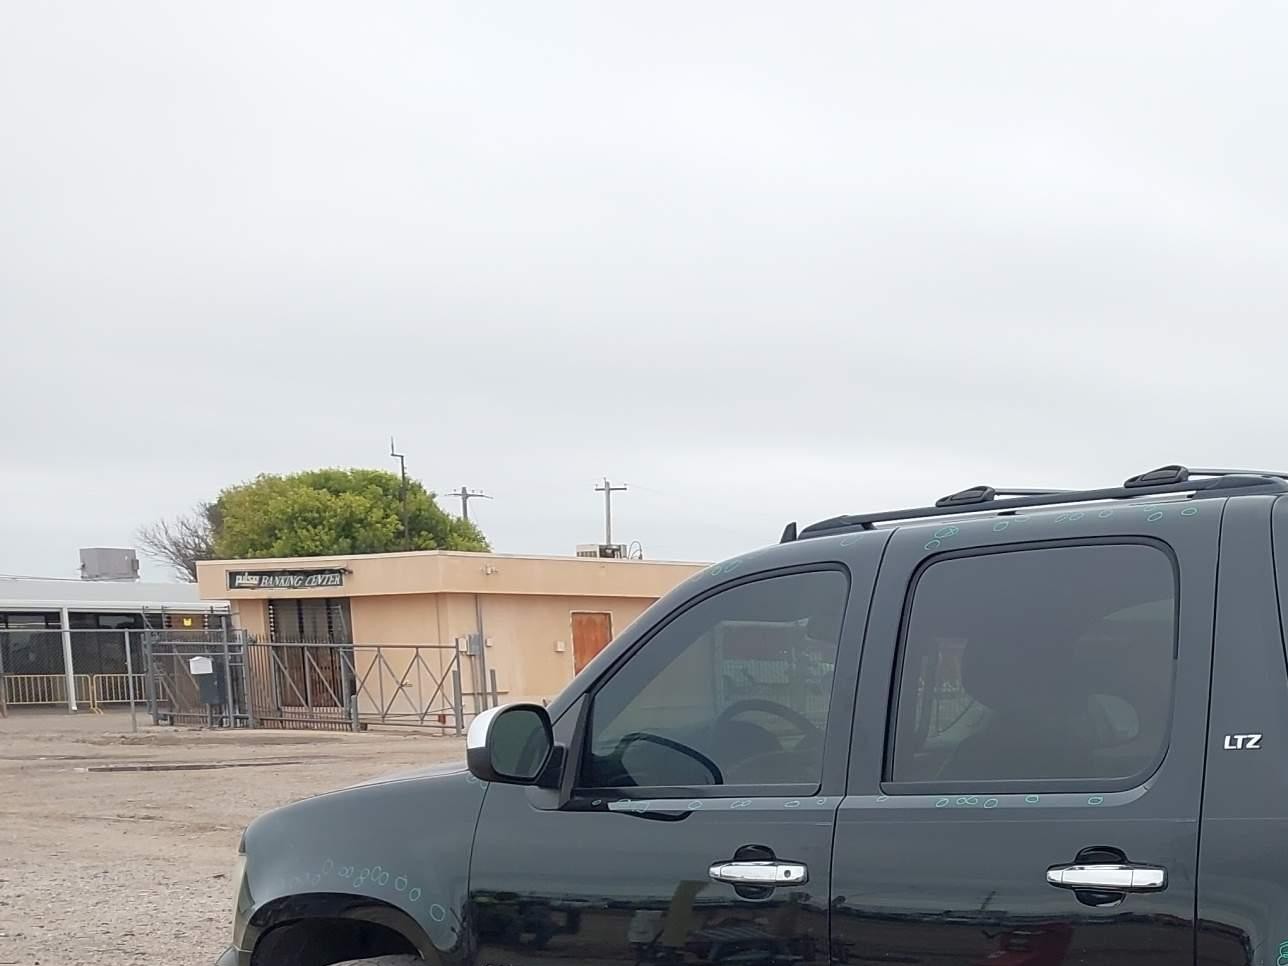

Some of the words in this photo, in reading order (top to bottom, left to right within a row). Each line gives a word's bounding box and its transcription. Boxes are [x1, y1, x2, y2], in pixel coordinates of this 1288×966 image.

[261, 575, 303, 587] BANKING
[305, 573, 341, 586] CENTER
[1224, 734, 1262, 750] LTZ
